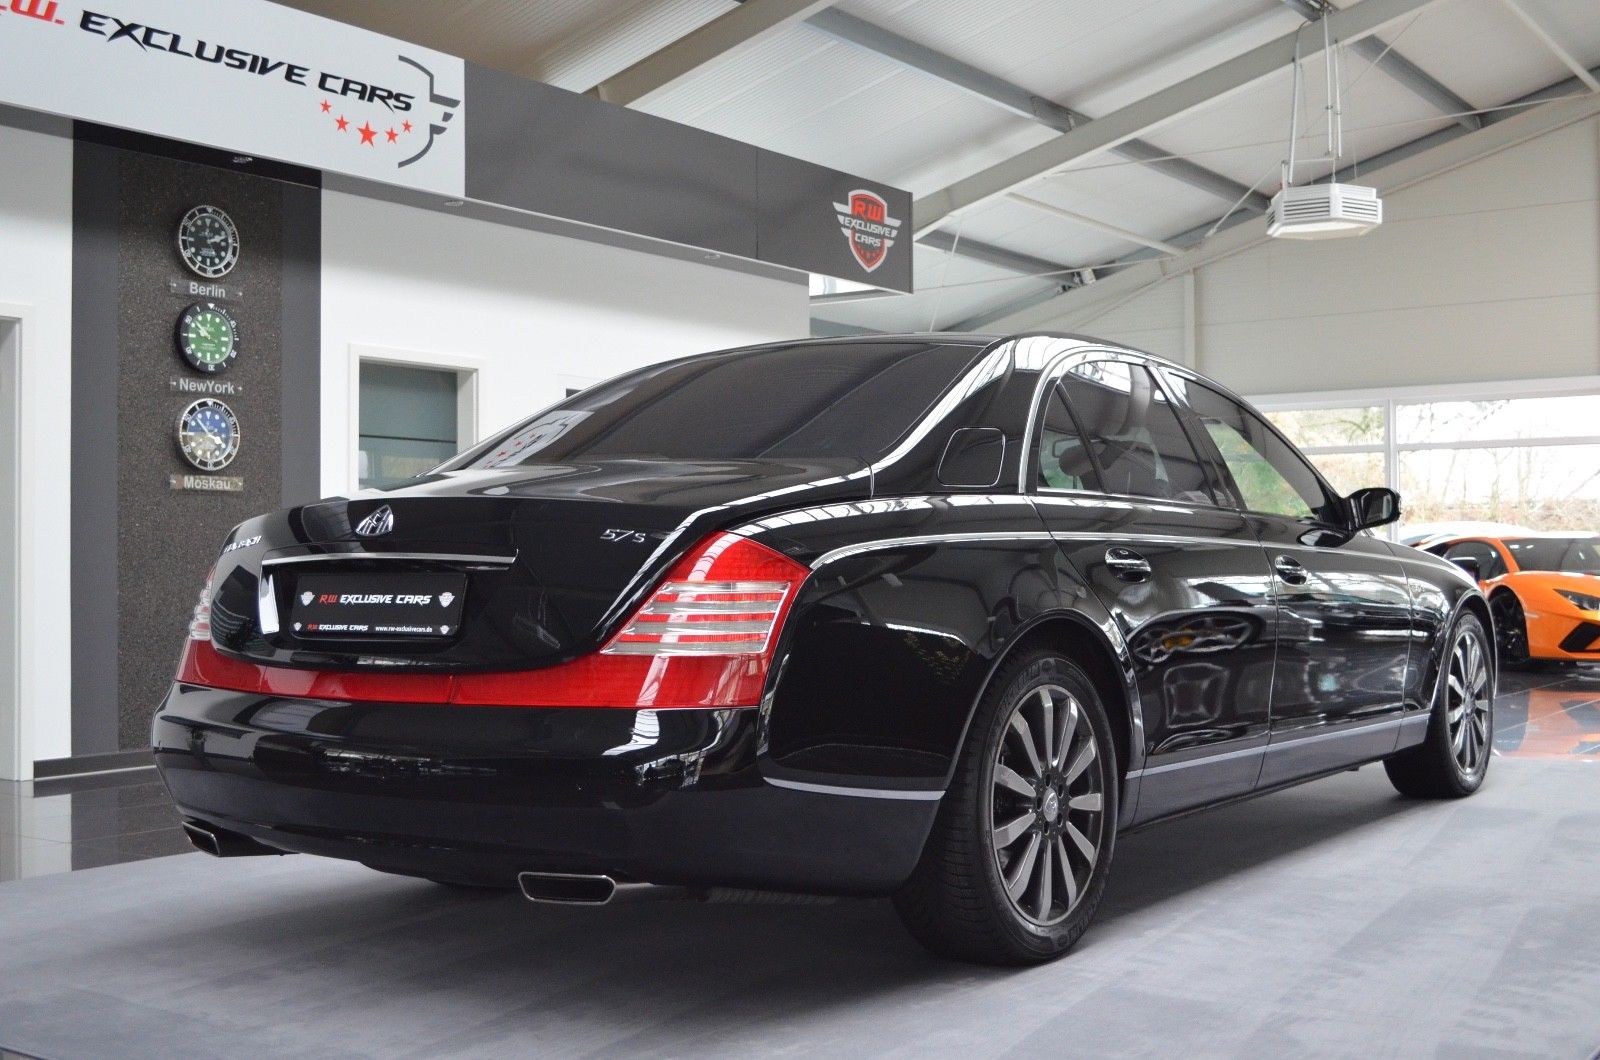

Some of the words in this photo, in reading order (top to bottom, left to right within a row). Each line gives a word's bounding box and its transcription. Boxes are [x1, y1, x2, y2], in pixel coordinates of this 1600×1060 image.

[79, 9, 310, 87] EXCLUSIVE
[318, 71, 415, 113] CARS
[853, 200, 882, 221] RW
[844, 217, 891, 237] EXCLUSIVE
[855, 233, 882, 247] CARS
[189, 282, 226, 298] Berlin
[179, 378, 235, 394] NewYork
[184, 476, 231, 490] Moskau
[319, 594, 338, 605] RW
[339, 594, 394, 605] EXCLUSIVE
[395, 594, 433, 606] CARS
[318, 624, 348, 632] EXCLUSIVE
[375, 625, 433, 633] www.rw-exclusivecars.de
